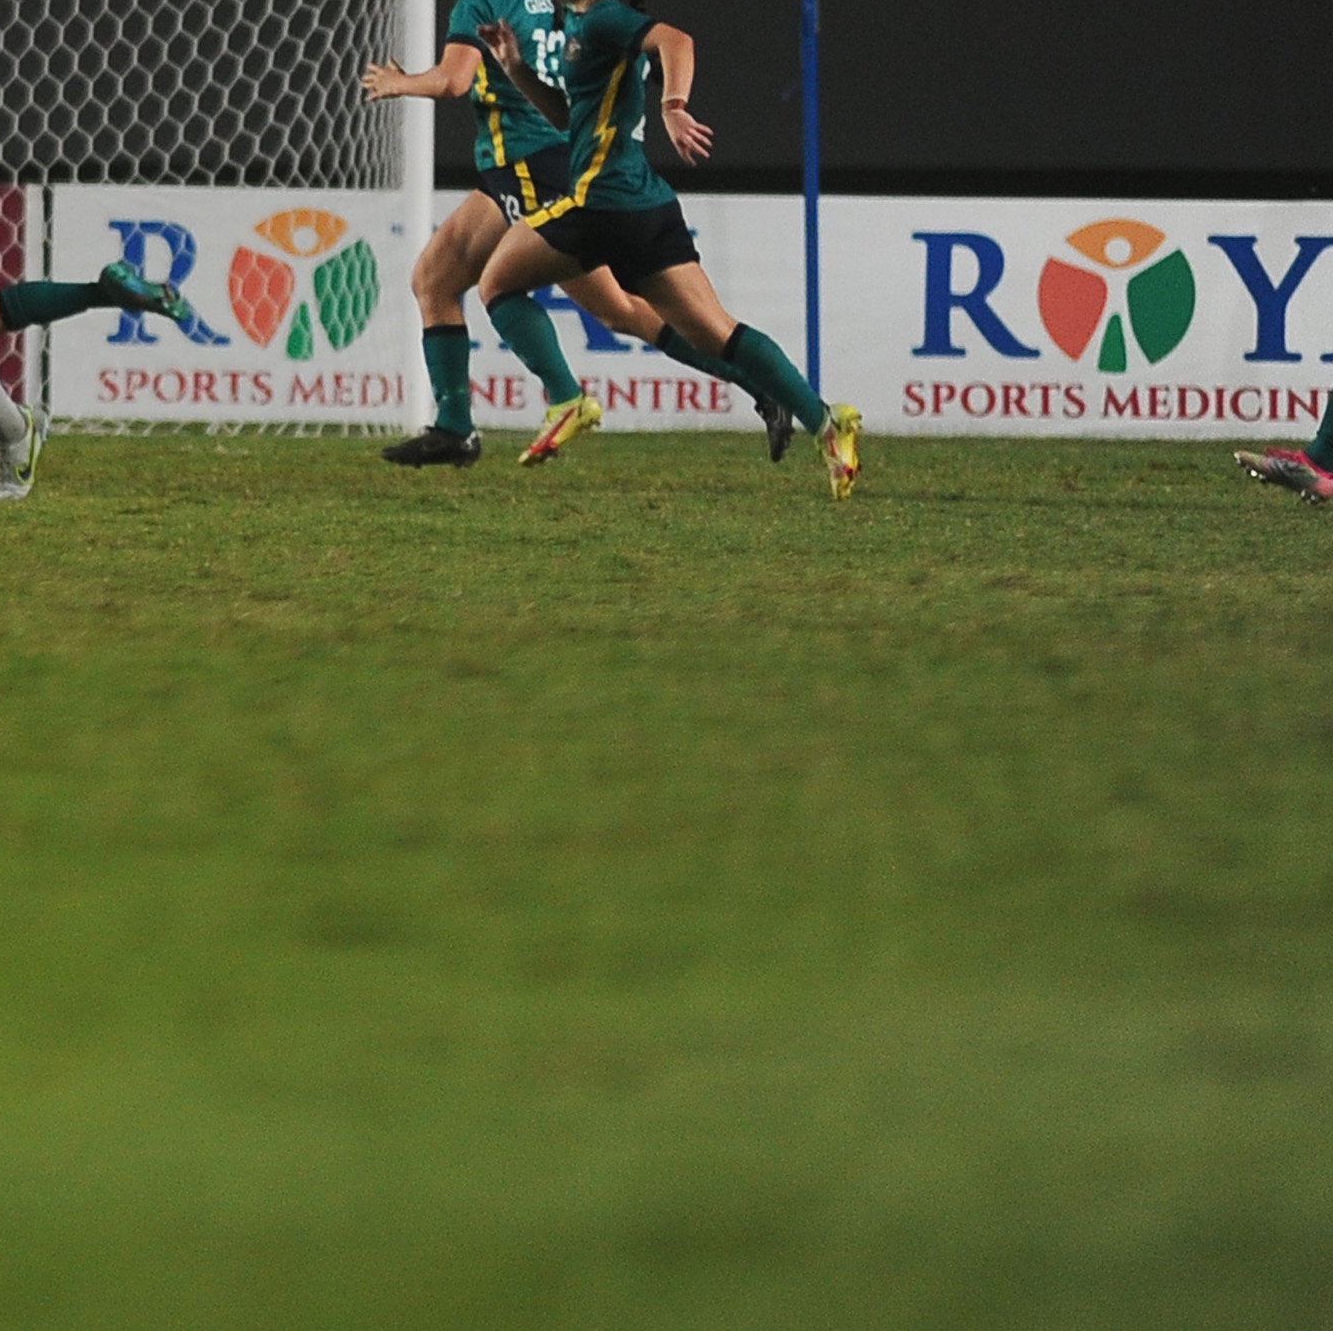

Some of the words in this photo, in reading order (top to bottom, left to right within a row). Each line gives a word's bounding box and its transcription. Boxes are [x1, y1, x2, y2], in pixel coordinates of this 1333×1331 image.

[97, 369, 275, 405] SPORTS
[902, 380, 1087, 420] SPORTS
[1103, 385, 1322, 423] MEDICIN
